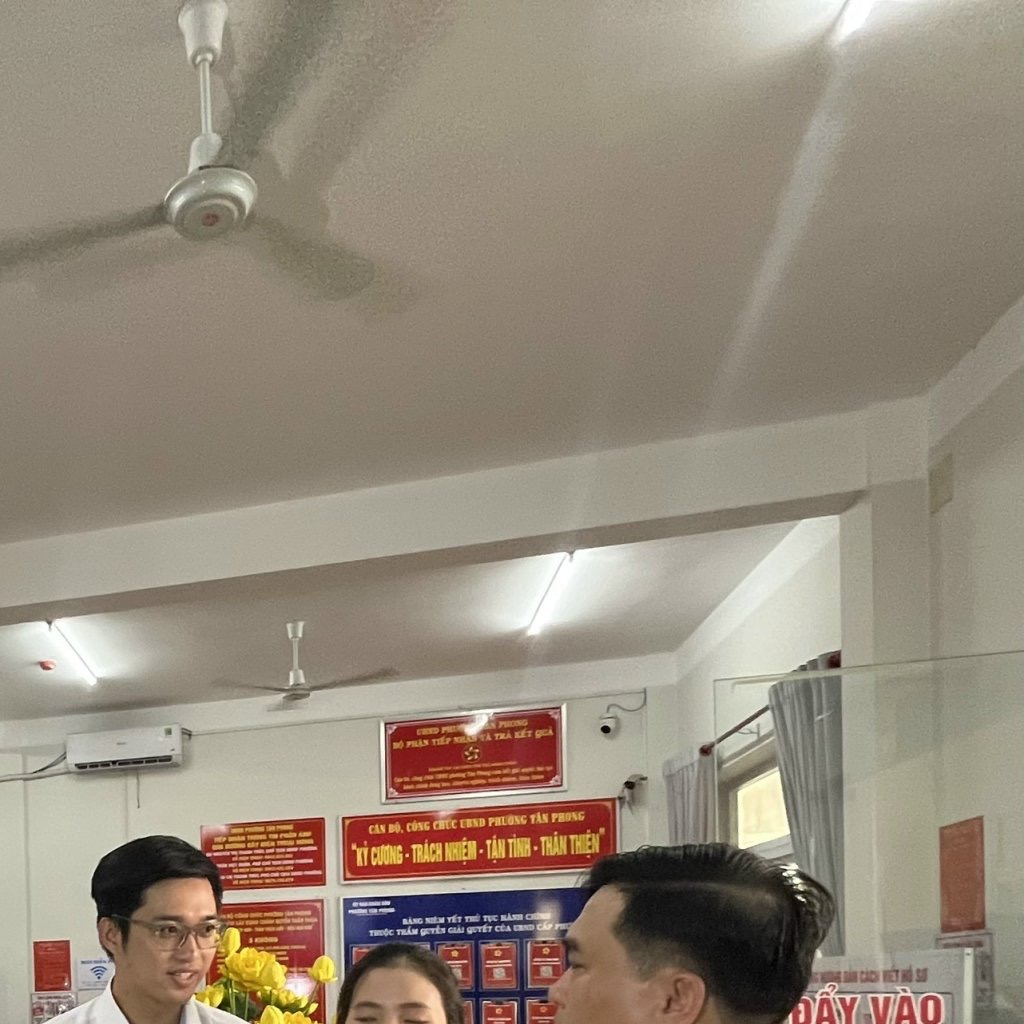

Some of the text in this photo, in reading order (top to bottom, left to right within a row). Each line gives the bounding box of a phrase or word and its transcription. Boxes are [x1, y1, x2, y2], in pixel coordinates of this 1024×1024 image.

[551, 811, 585, 823] PHONG
[411, 839, 443, 864] TRÁCH
[445, 837, 477, 866] NHIỆM
